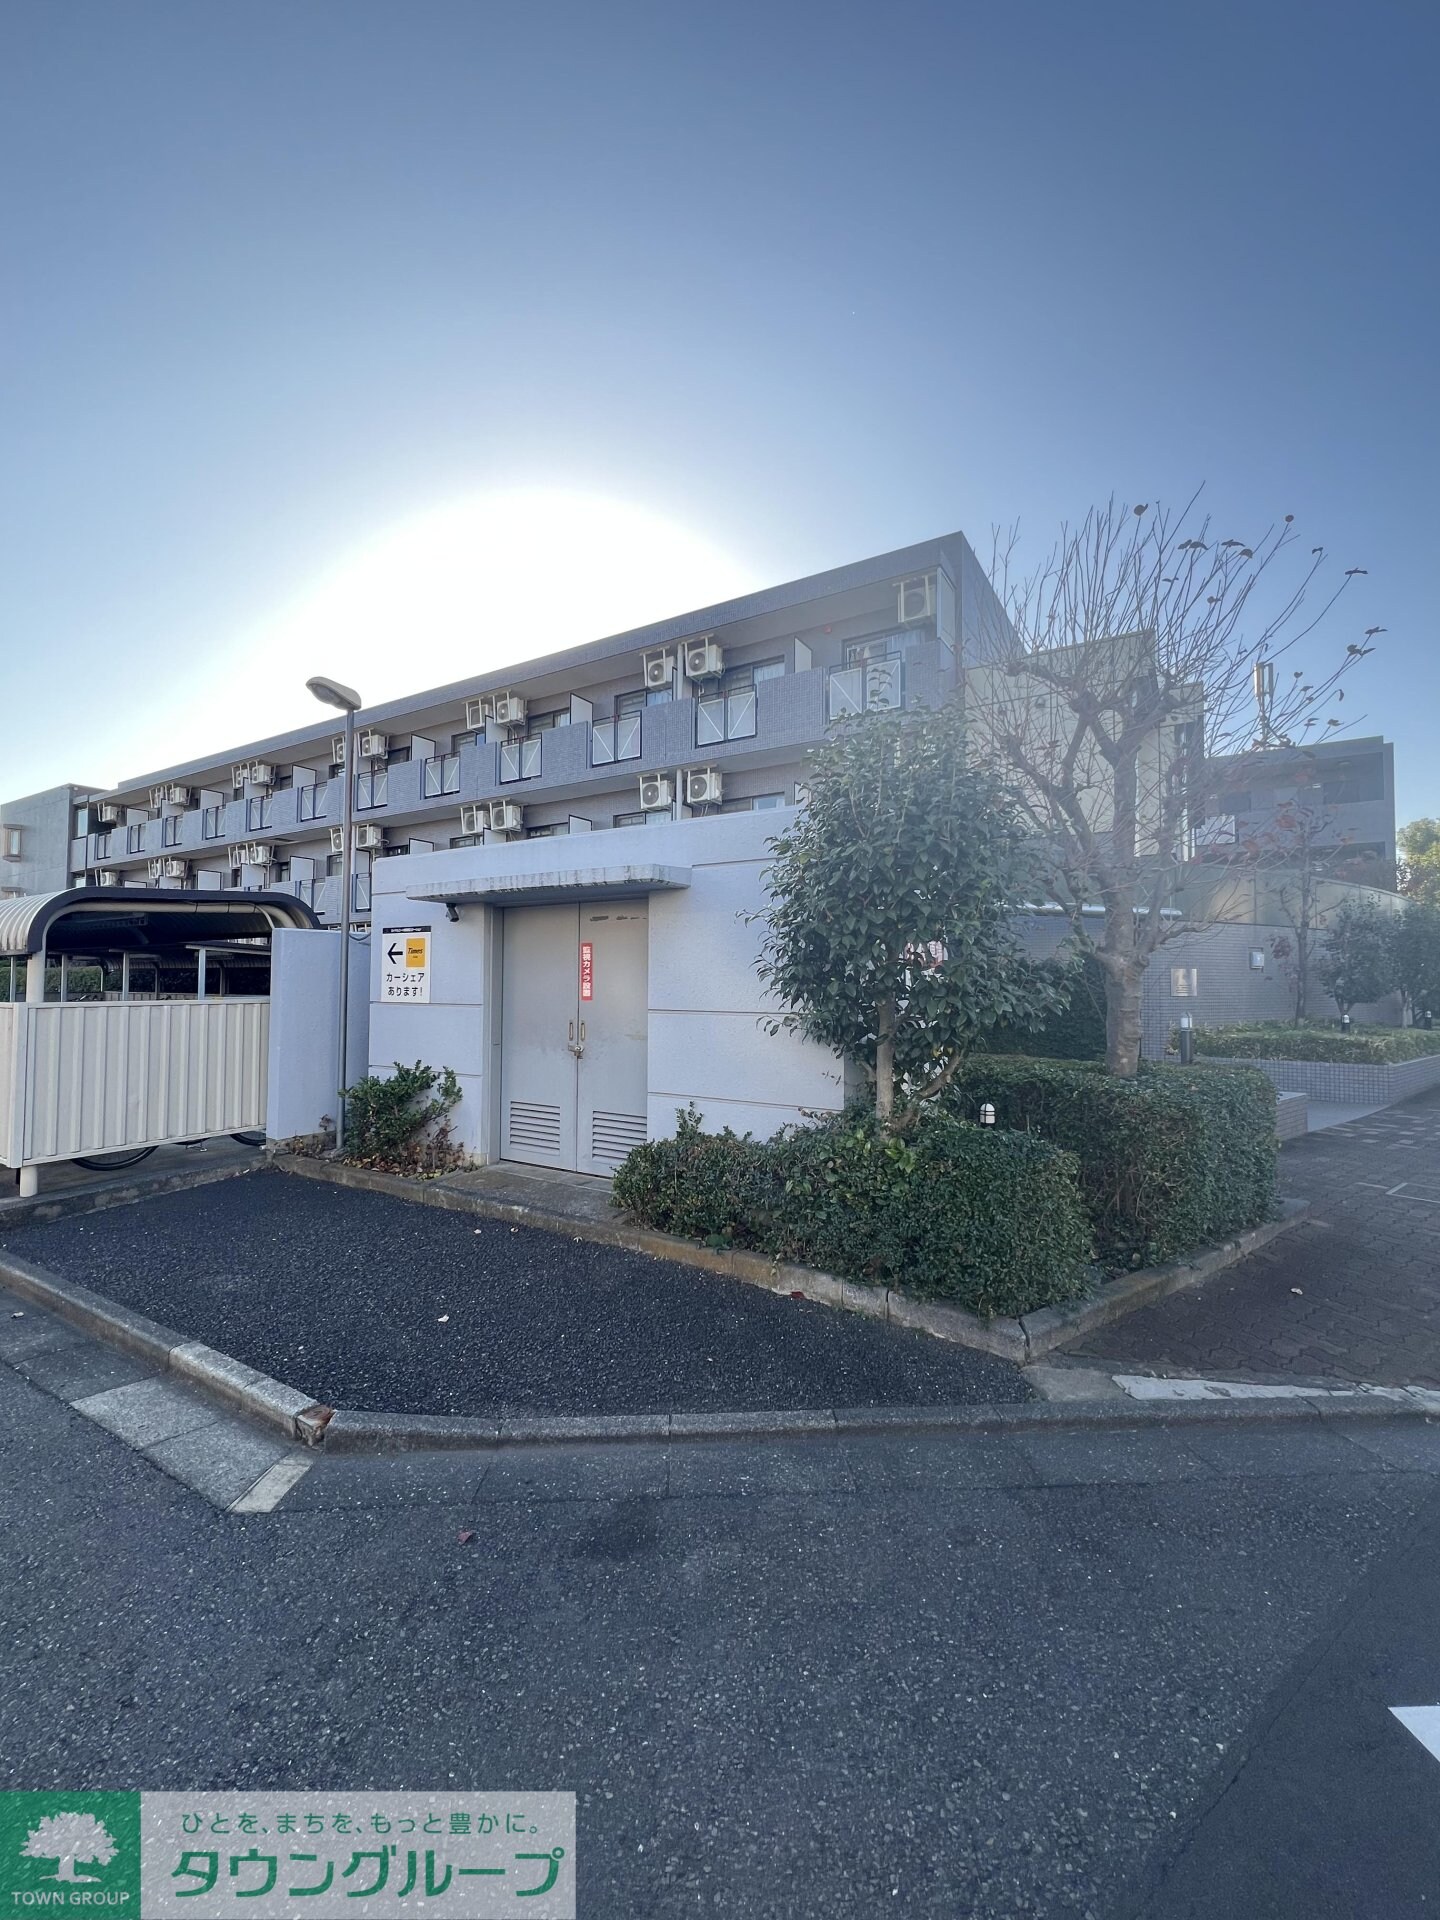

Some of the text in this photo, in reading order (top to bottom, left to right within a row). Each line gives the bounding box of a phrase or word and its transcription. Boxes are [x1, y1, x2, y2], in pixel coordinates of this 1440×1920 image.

[408, 947, 424, 955] Times
[386, 972, 425, 983] カーシェア
